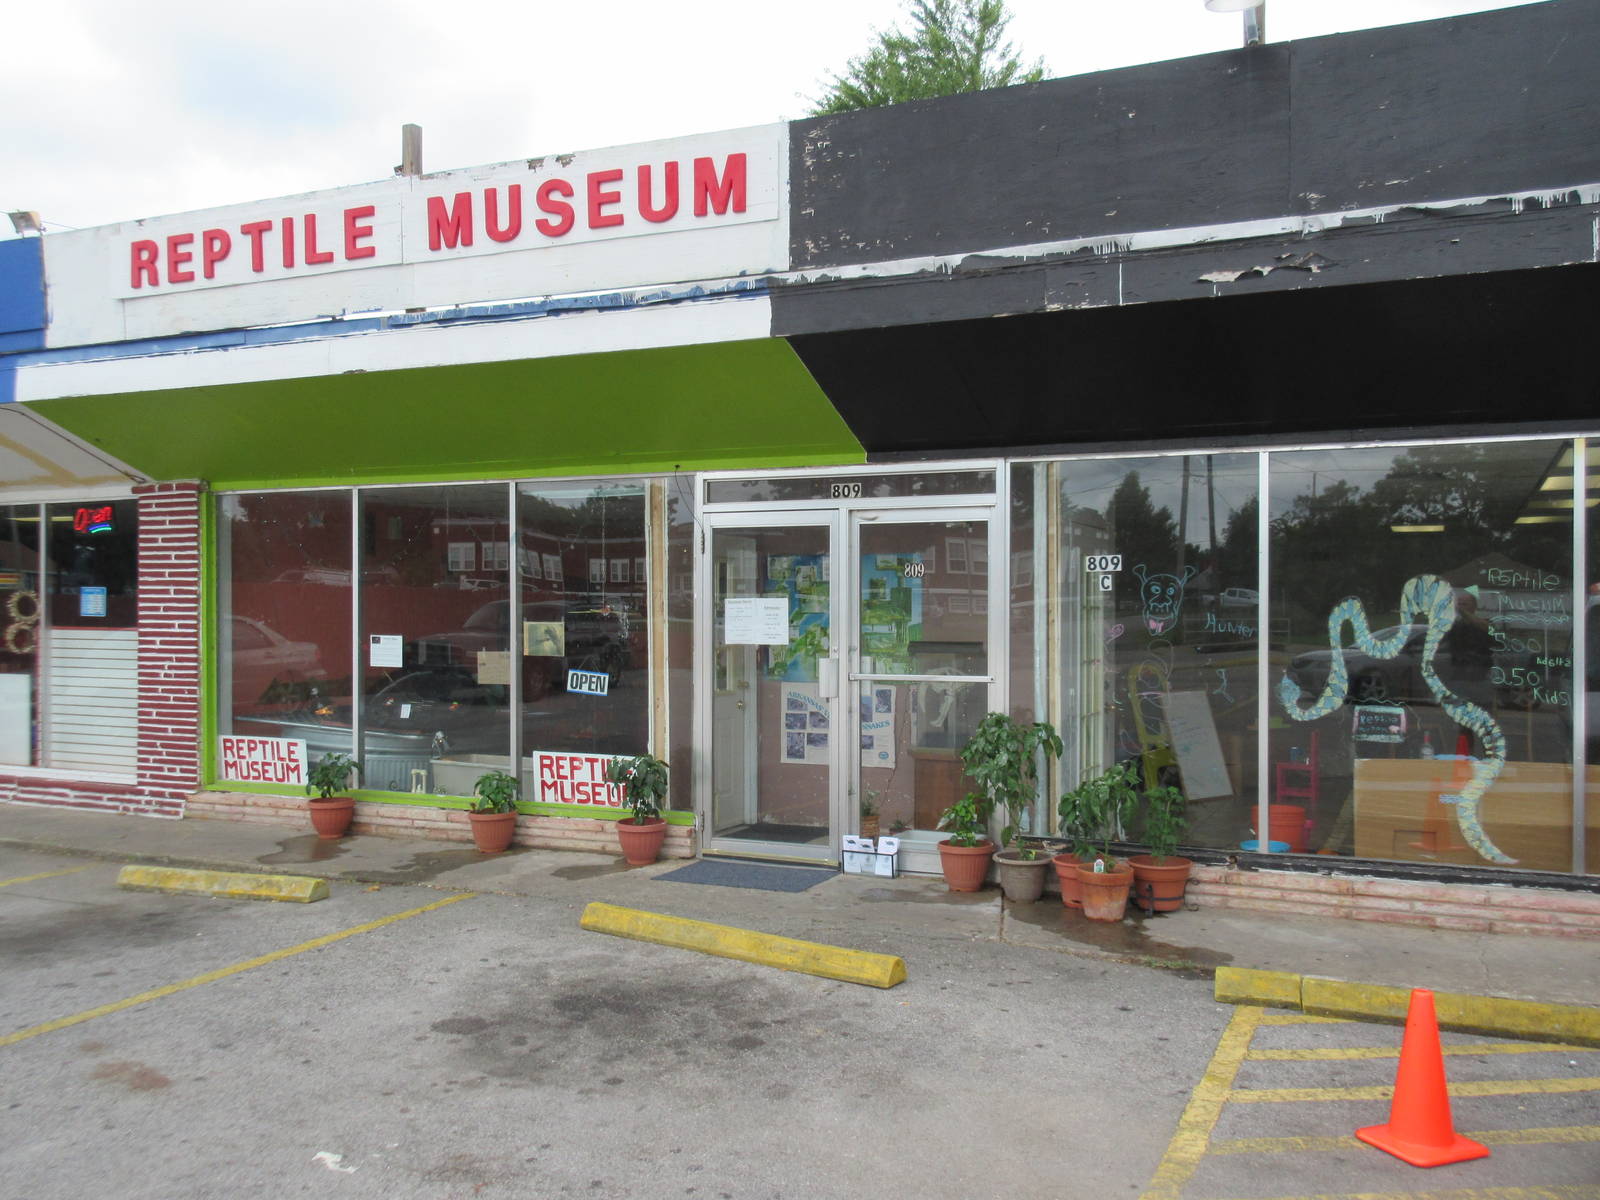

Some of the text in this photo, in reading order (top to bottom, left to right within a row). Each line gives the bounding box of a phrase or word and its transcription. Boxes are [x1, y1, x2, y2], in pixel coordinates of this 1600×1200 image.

[130, 153, 747, 288] REPTILE MUSEUM
[832, 483, 861, 499] 809
[904, 562, 925, 578] 809
[1088, 555, 1121, 571] 809
[1100, 575, 1111, 590] C
[570, 672, 606, 693] OPEN
[223, 737, 299, 763] REPTILE
[224, 759, 301, 784] MUSEUM
[540, 779, 631, 808] MUSEU
